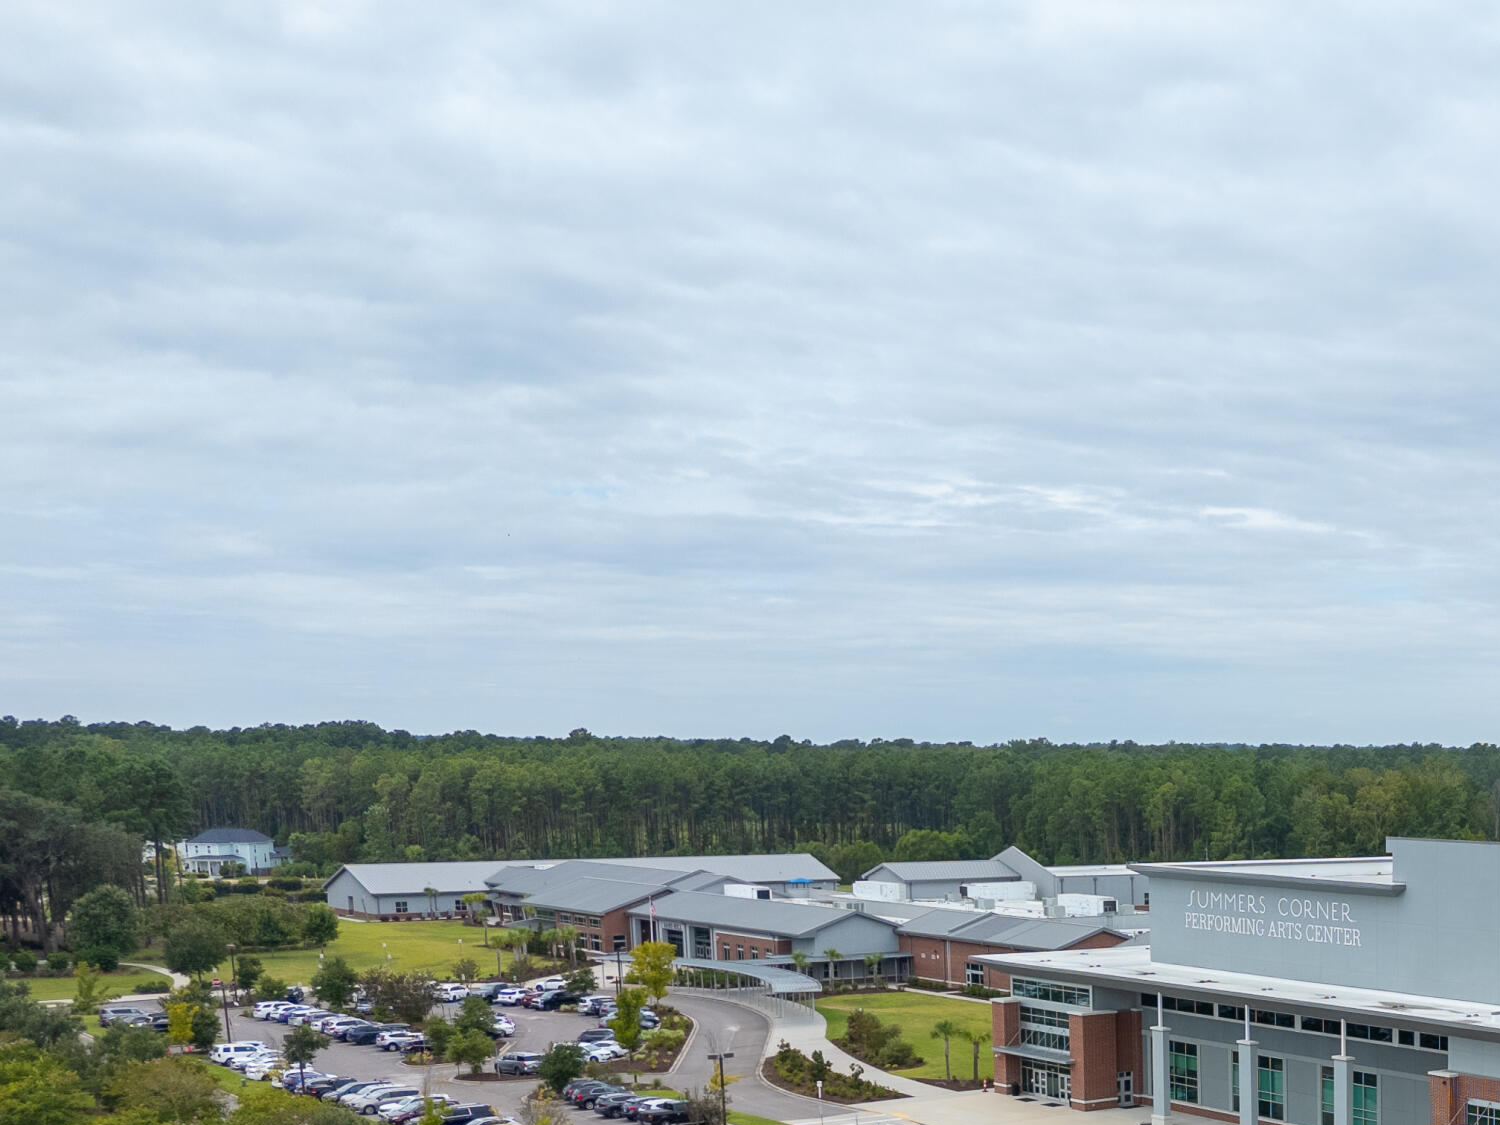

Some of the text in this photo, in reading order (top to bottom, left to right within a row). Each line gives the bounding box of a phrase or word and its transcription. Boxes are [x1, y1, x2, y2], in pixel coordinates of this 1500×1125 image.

[1187, 890, 1357, 923] SUMMERS CORNER
[1185, 912, 1361, 947] PERFORMING ARTS CENTER
